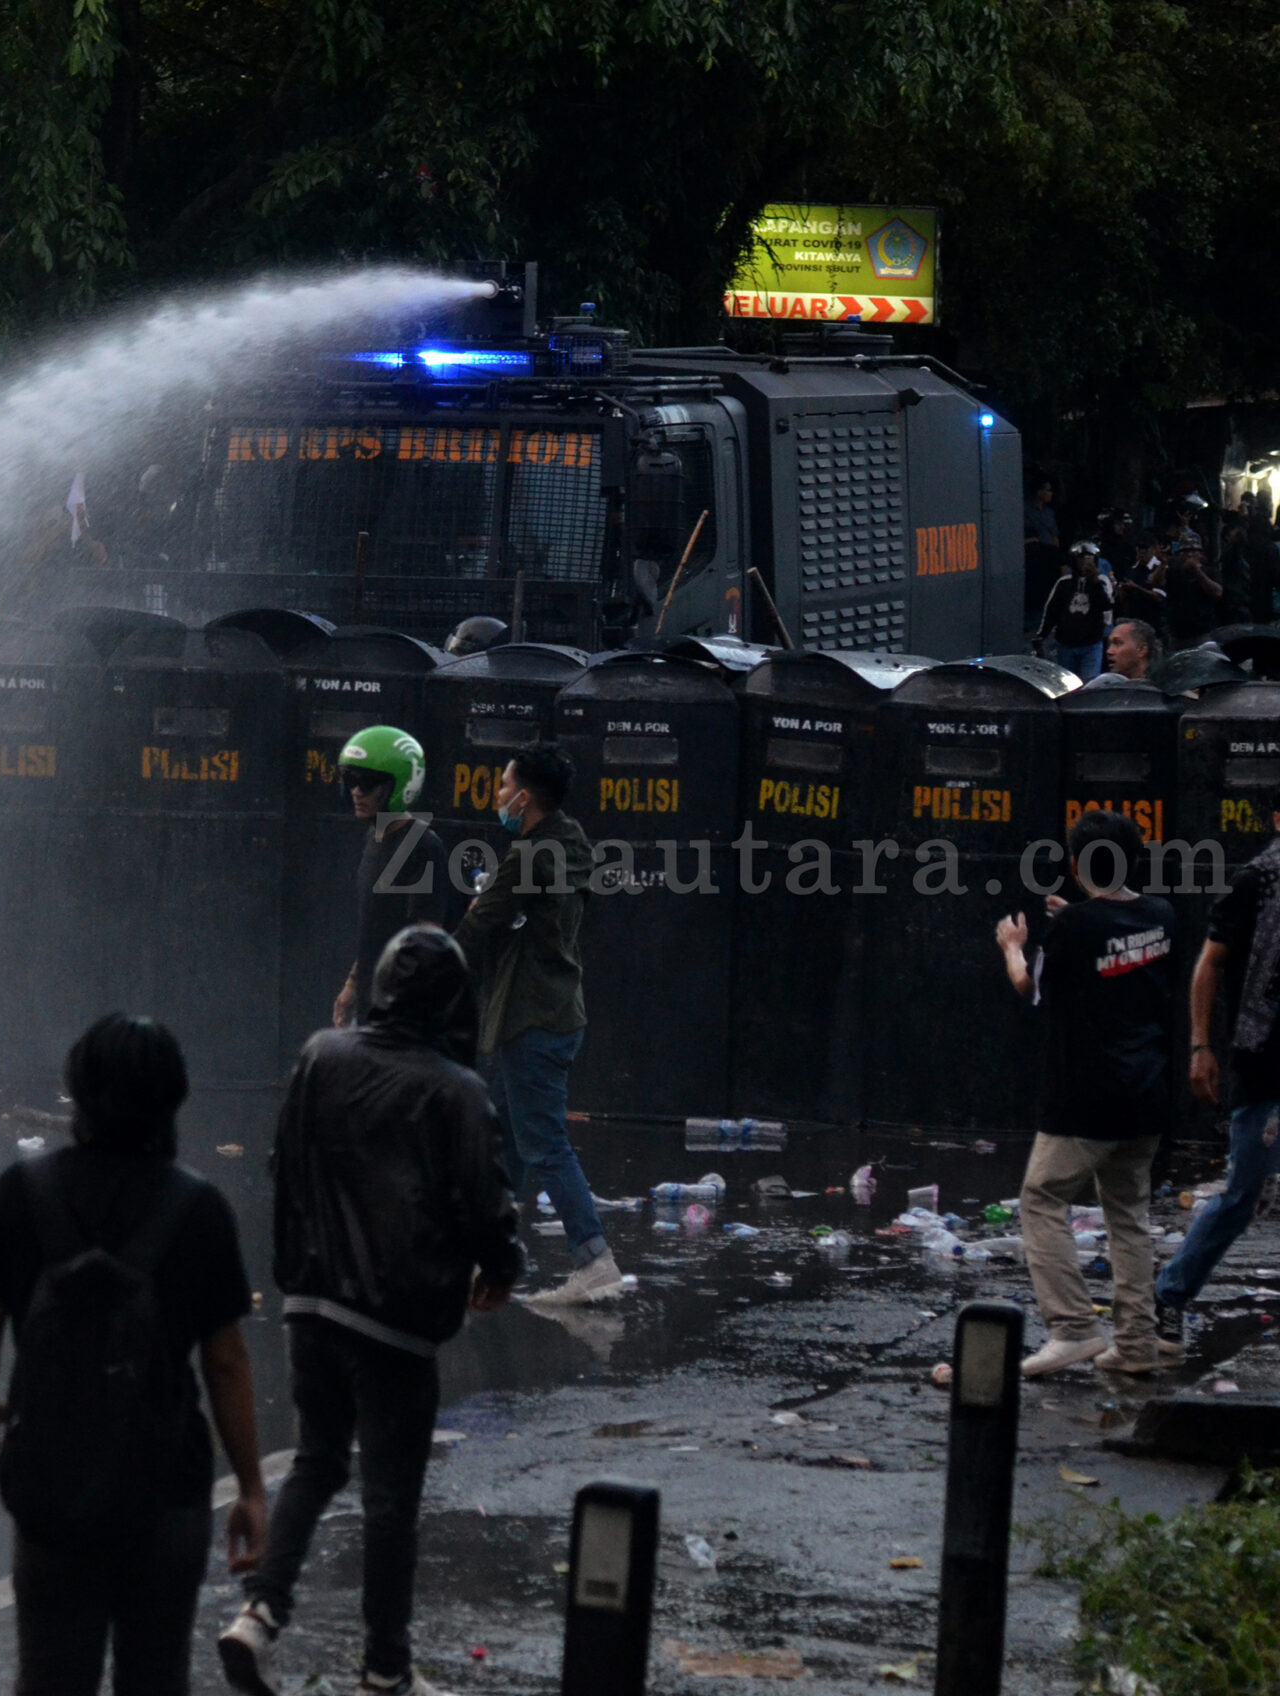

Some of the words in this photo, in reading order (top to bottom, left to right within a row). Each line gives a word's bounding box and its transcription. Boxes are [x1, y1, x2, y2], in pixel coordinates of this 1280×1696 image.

[803, 239, 862, 249] COVID-19
[794, 251, 862, 263] KITAWAYA
[915, 522, 979, 577] BRIMOB
[7, 678, 17, 689] A
[342, 681, 352, 691] A
[354, 680, 382, 693] POR
[607, 720, 632, 733] DEN
[633, 721, 643, 733] A
[644, 721, 671, 734] POR
[772, 715, 801, 730] YON
[802, 718, 812, 731] A
[814, 720, 843, 733] POR
[1229, 742, 1255, 753] DEN
[1256, 742, 1266, 753] A
[599, 777, 680, 813] POLISI
[758, 778, 840, 819] POLISI
[913, 786, 1012, 822] POLISI
